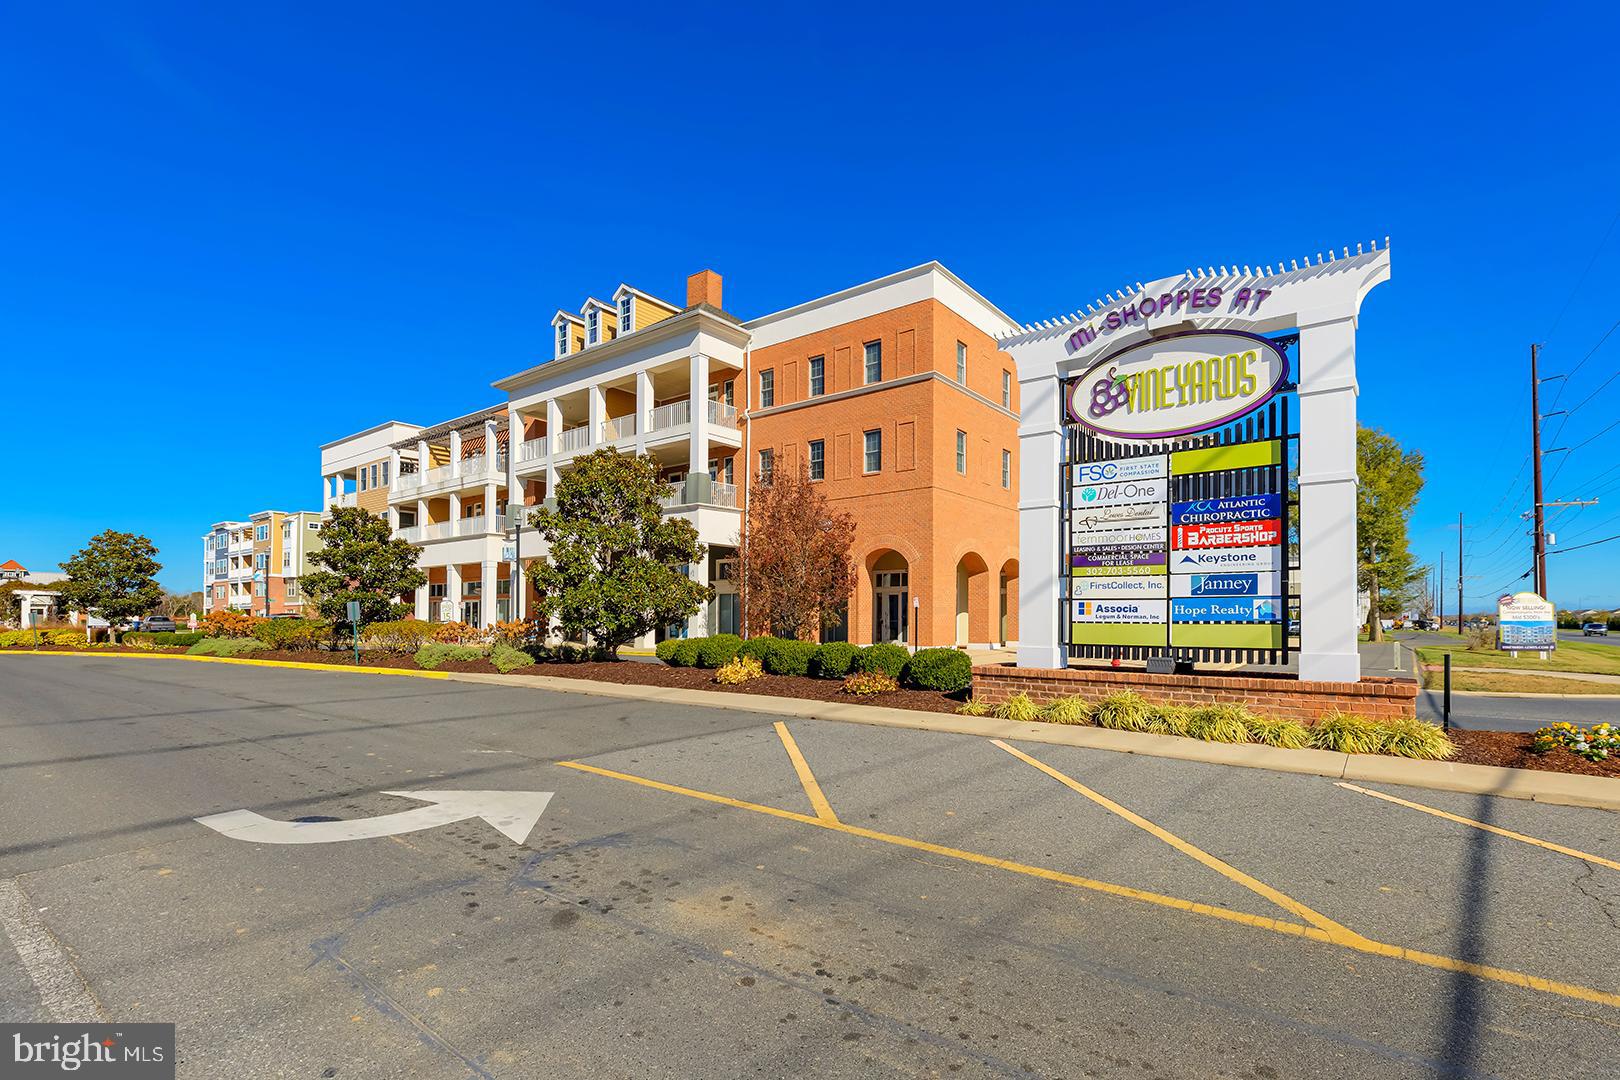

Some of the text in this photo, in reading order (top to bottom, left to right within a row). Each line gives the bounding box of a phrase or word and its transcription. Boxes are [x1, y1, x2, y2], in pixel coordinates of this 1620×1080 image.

[1235, 287, 1271, 310] AT
[1124, 350, 1257, 413] VINEYARDS
[1079, 463, 1117, 482] FSC
[1120, 469, 1159, 477] COMPASSION
[1097, 484, 1155, 500] Del-One
[1218, 498, 1266, 509] ATLANTIC
[1125, 506, 1155, 517] Dental
[1180, 508, 1270, 523] CHIROPRACTIC
[1187, 531, 1277, 546] BARBERSHOP
[1087, 554, 1128, 562] COMMERCIAL
[1198, 553, 1257, 564] Keystone
[1086, 567, 1151, 575] 302-703-5560
[1089, 581, 1164, 590] FirstCollect, Inc.
[1197, 576, 1253, 593] Janney
[1095, 604, 1139, 613] Associa
[1174, 604, 1252, 616] Hope Realty
